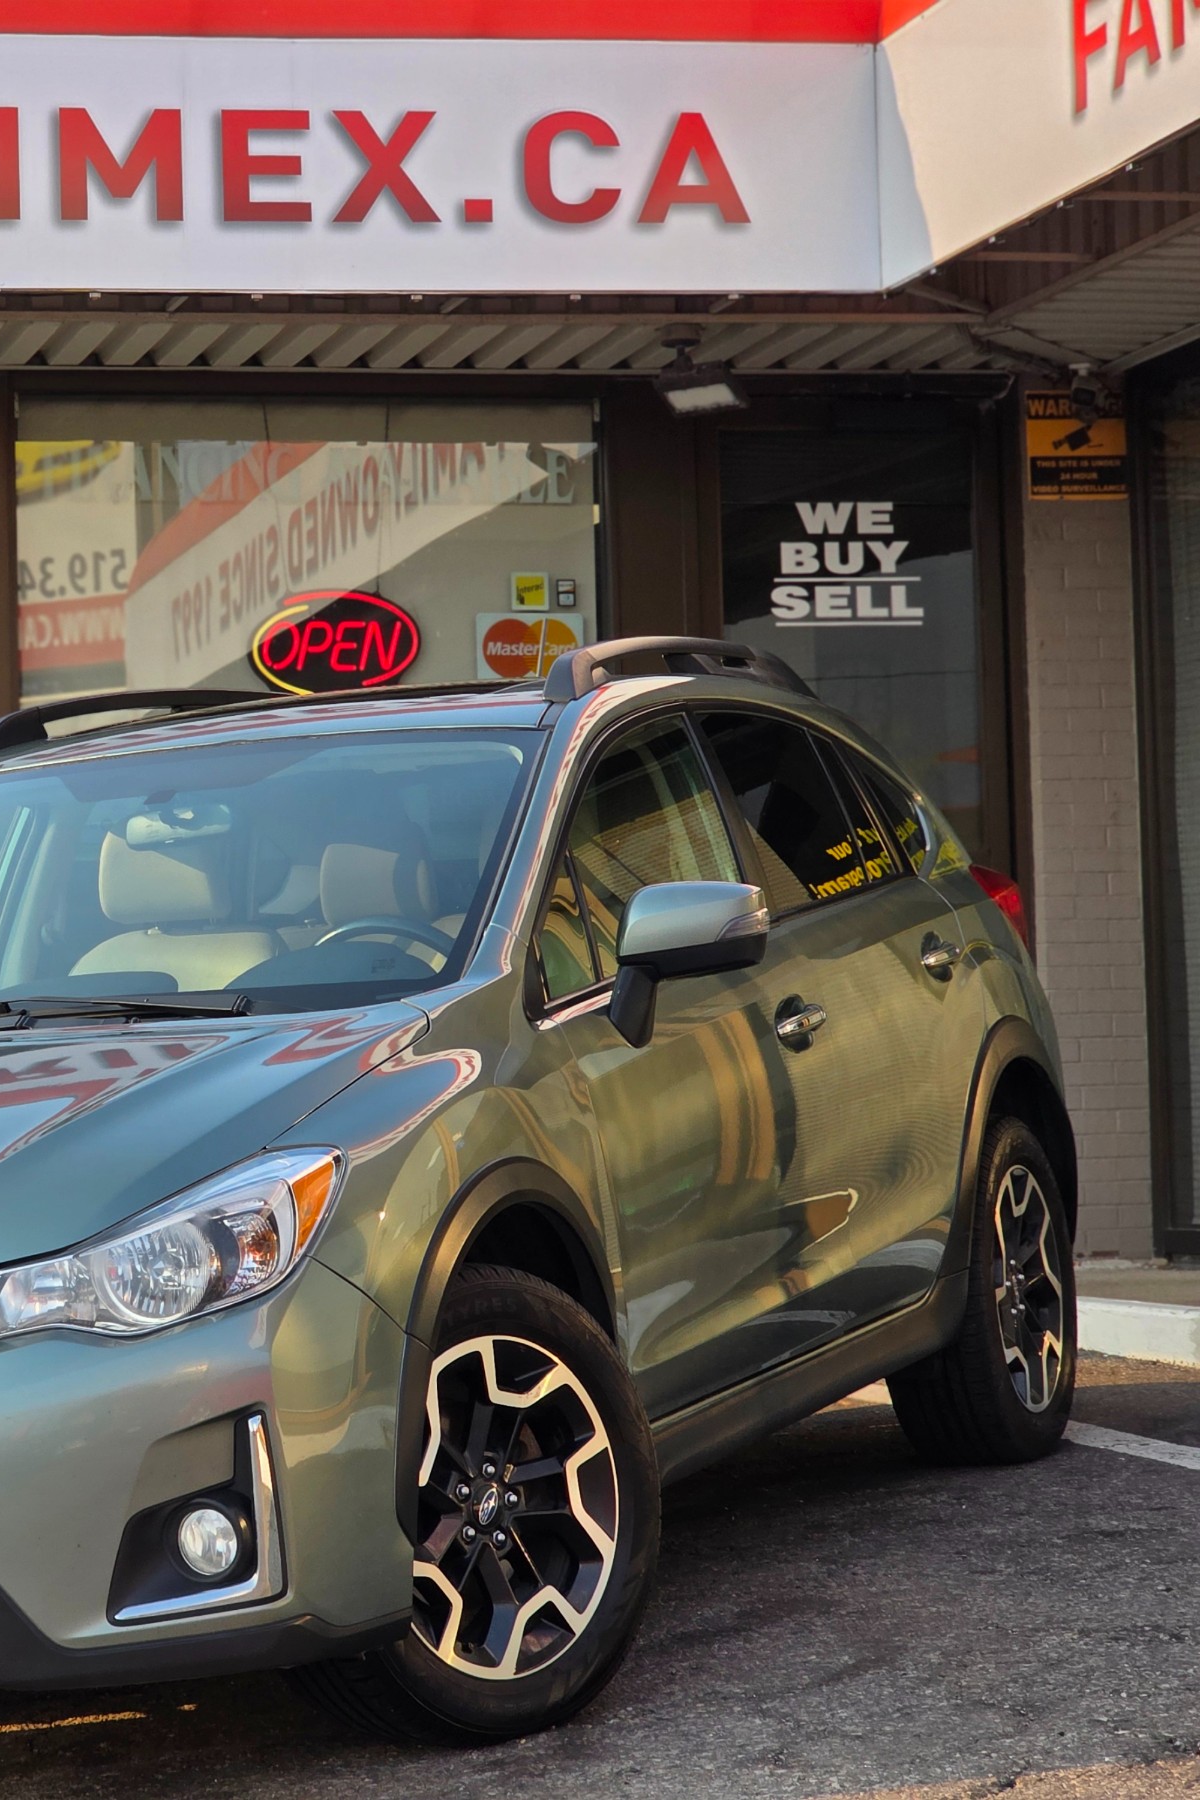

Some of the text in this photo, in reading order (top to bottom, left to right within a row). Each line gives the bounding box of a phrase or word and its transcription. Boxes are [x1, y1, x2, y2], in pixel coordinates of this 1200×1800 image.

[1028, 398, 1122, 417] WARG
[1036, 460, 1056, 468] THIS
[1059, 460, 1077, 468] SITE
[1033, 485, 1059, 493] VIDEO
[795, 502, 895, 534] WE
[780, 541, 910, 574] BUY
[770, 585, 924, 619] SELL
[261, 621, 401, 671] OPEN
